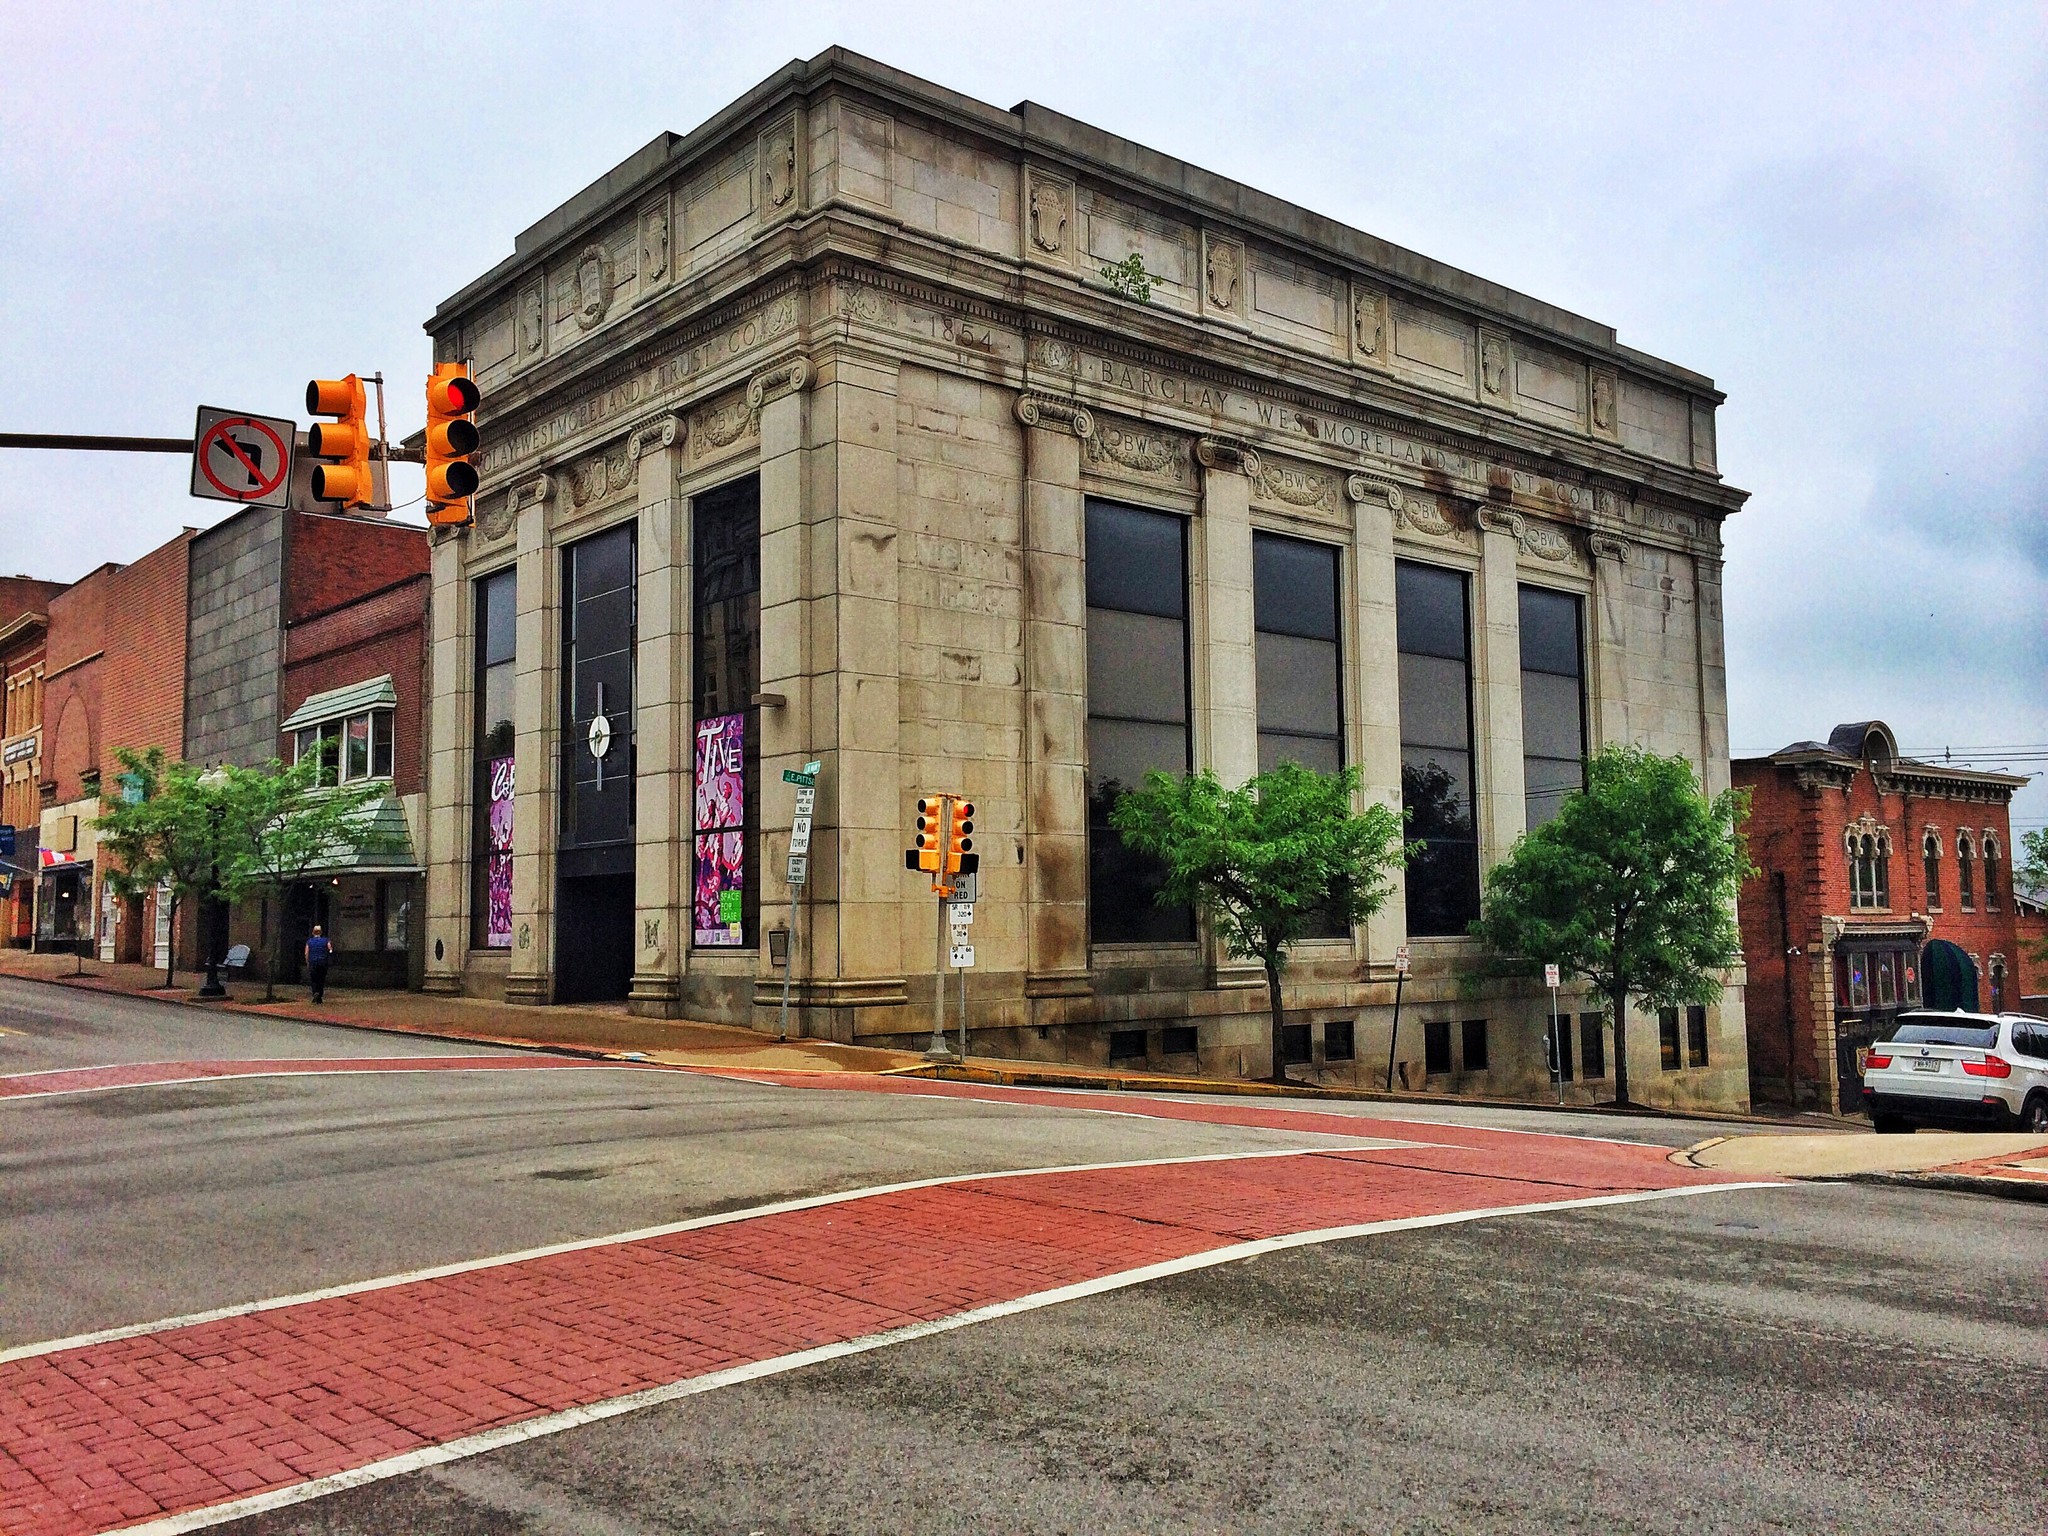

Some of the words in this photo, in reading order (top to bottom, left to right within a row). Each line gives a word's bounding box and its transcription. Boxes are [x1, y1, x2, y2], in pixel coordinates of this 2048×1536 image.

[930, 316, 993, 352] 1854
[657, 342, 712, 389] TRUST
[1124, 434, 1147, 454] BW
[1285, 472, 1305, 490] BW
[1470, 457, 1534, 492] TRUST
[1422, 503, 1440, 520] BW
[1642, 505, 1675, 531] 1928
[1540, 532, 1558, 547] BW
[698, 720, 741, 784] TIVE
[797, 822, 806, 833] NO
[792, 838, 807, 848] TURNS
[956, 880, 966, 889] ON
[721, 892, 740, 901] SPACE
[954, 891, 968, 899] RED
[721, 902, 732, 911] FOR
[721, 912, 737, 920] LEASE
